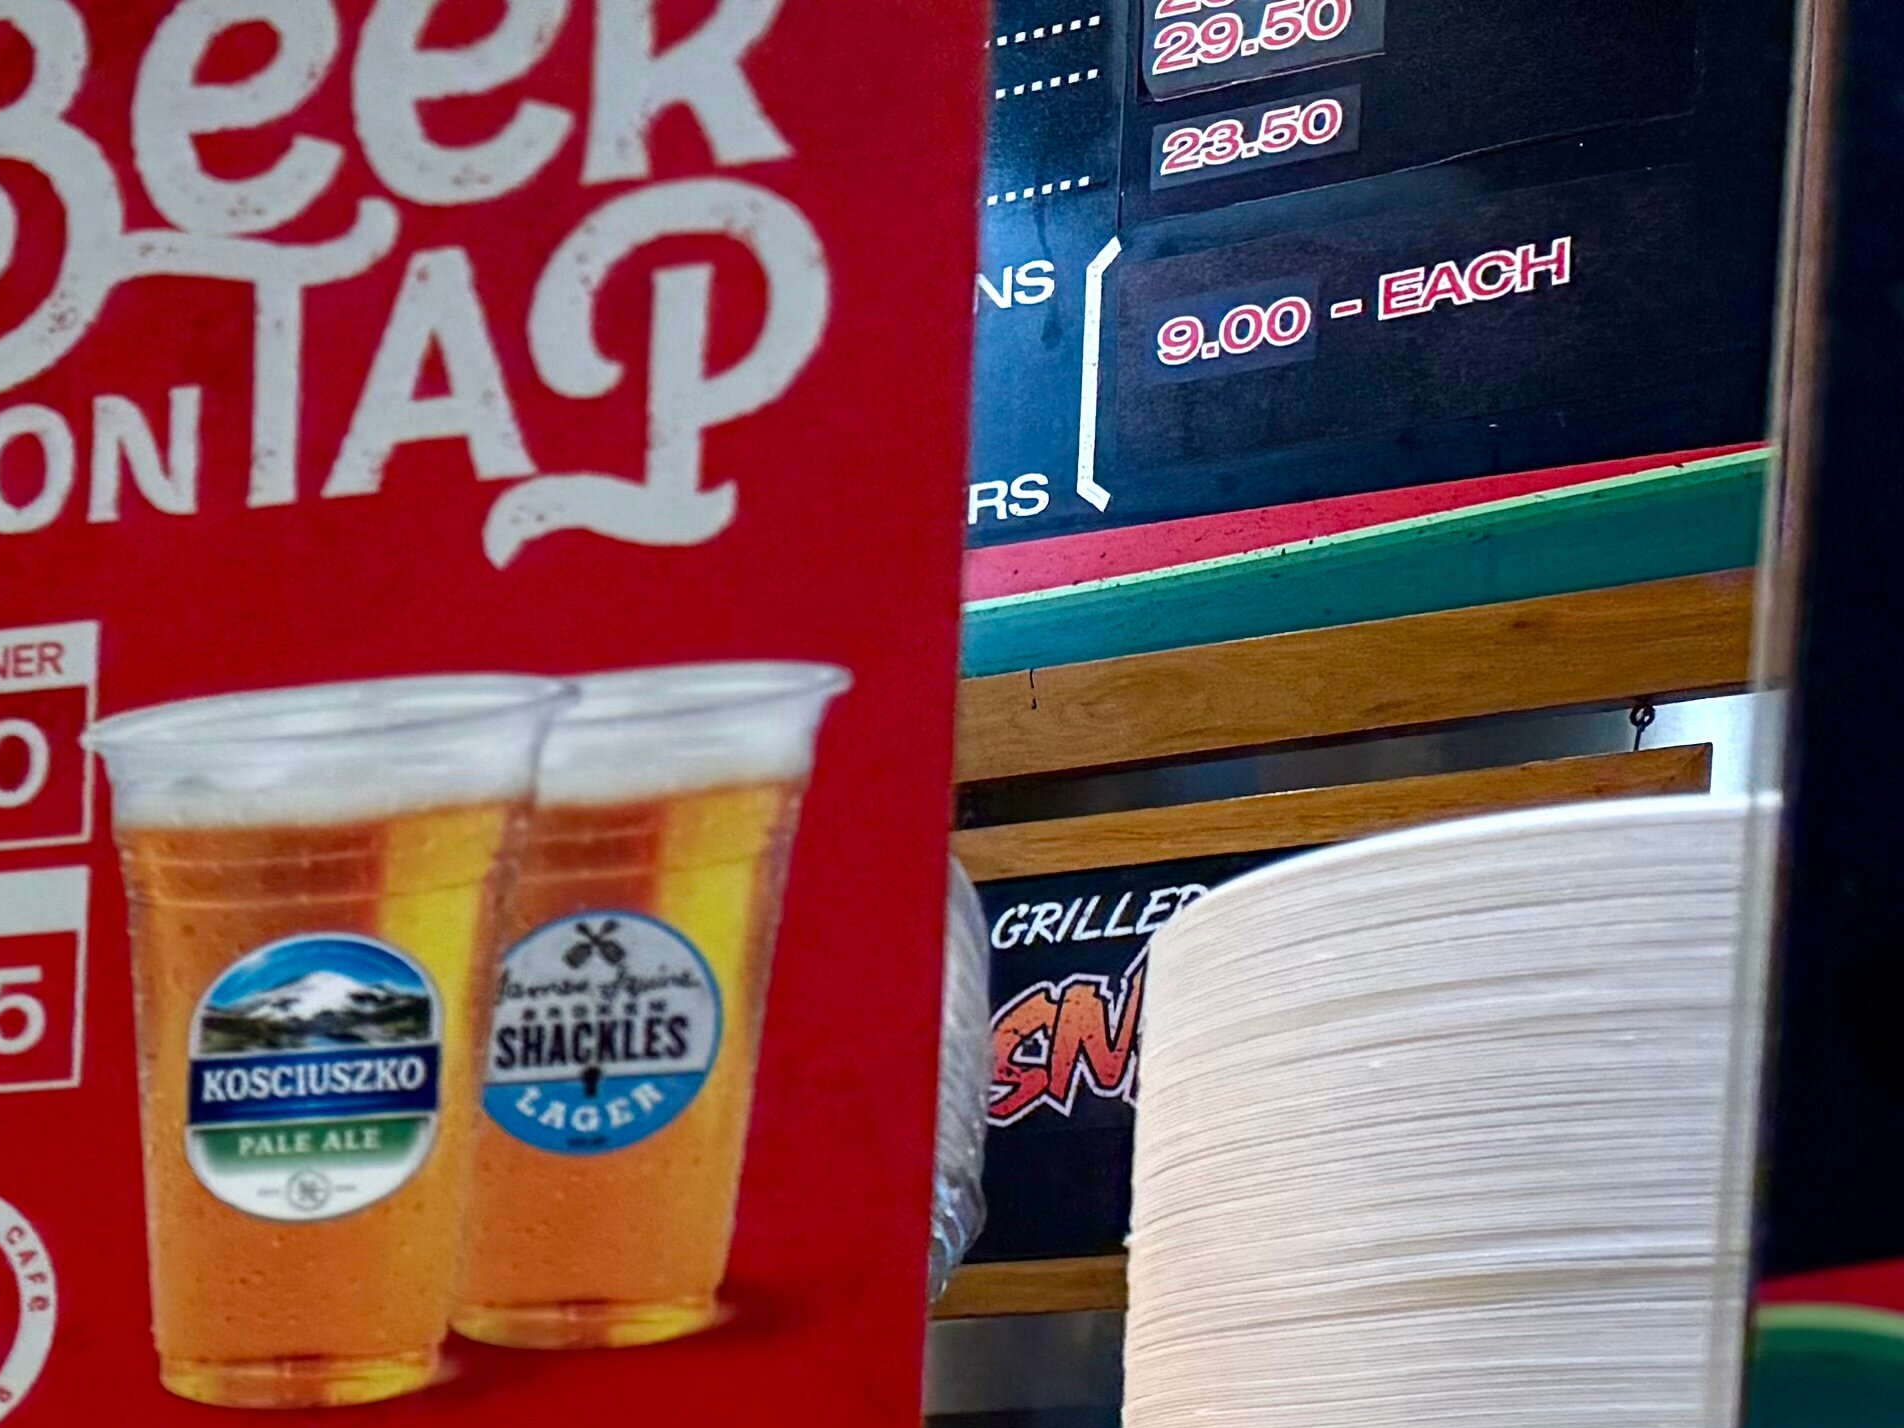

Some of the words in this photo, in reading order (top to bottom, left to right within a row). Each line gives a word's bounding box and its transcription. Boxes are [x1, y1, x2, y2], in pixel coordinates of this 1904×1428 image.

[1153, 0, 1352, 75] 29.50
[1161, 99, 1343, 175] 23.50
[1155, 295, 1311, 368] 9.00
[1377, 237, 1572, 320] EACH
[135, 179, 831, 572] TAP
[495, 1016, 689, 1069] SHACKLES
[202, 1056, 426, 1103] KOSCIUSZKO
[515, 1082, 665, 1132] LAGER
[239, 1133, 311, 1157] PALE
[322, 1127, 382, 1152] ALE
